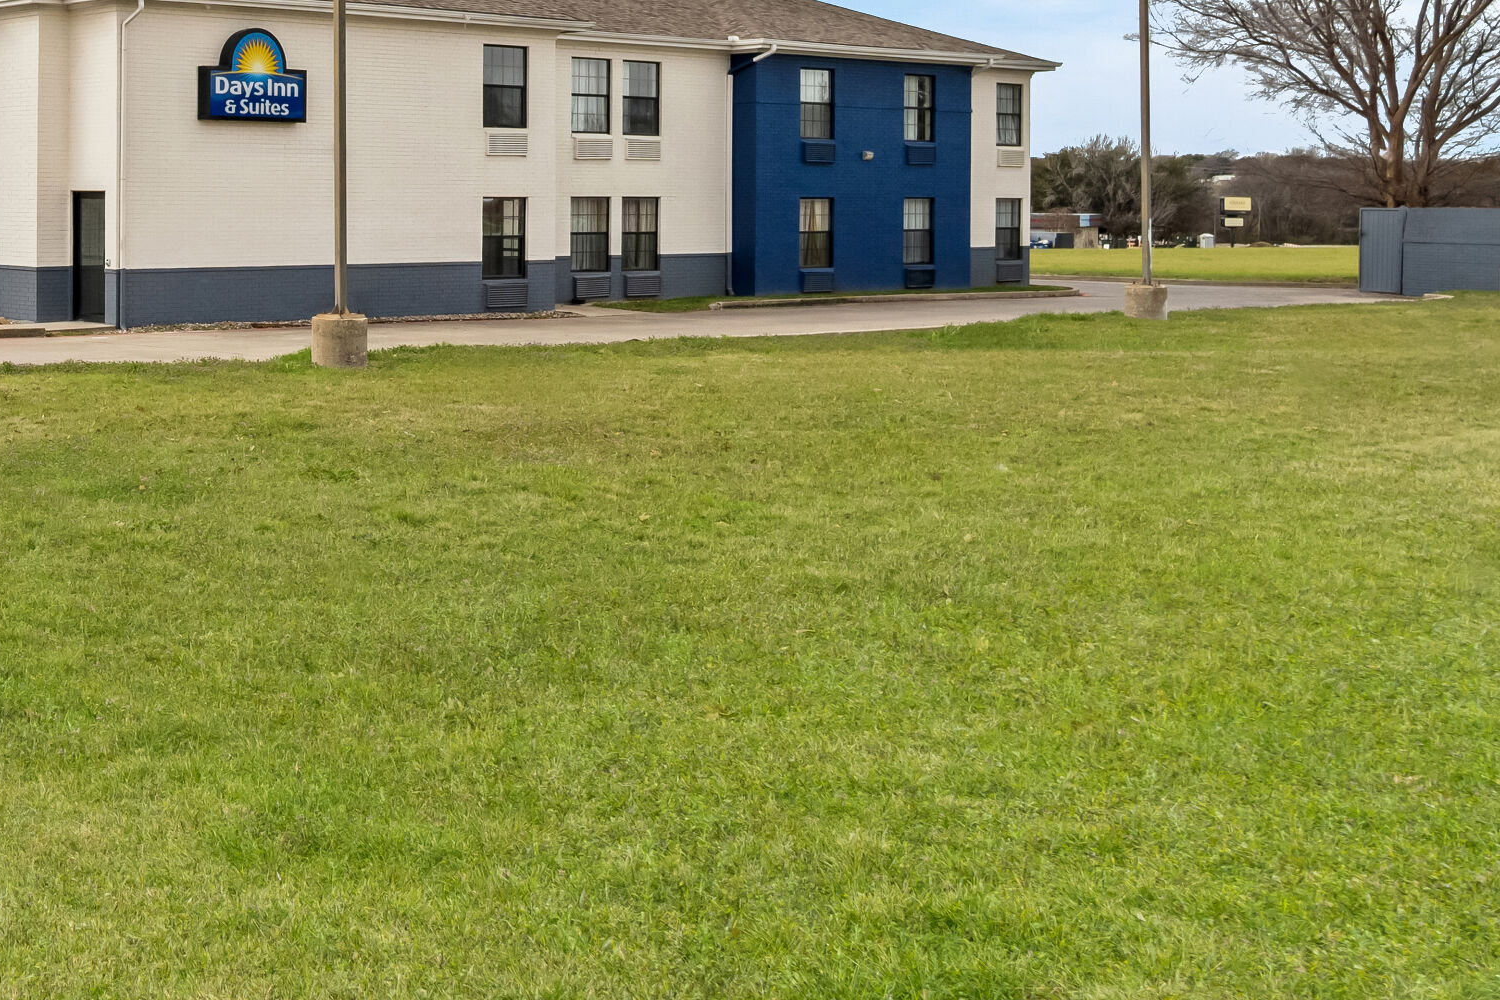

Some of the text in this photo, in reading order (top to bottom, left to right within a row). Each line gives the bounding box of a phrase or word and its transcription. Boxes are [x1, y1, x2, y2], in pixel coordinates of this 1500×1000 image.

[215, 76, 299, 98] Days Inn
[224, 98, 290, 116] & Suites
